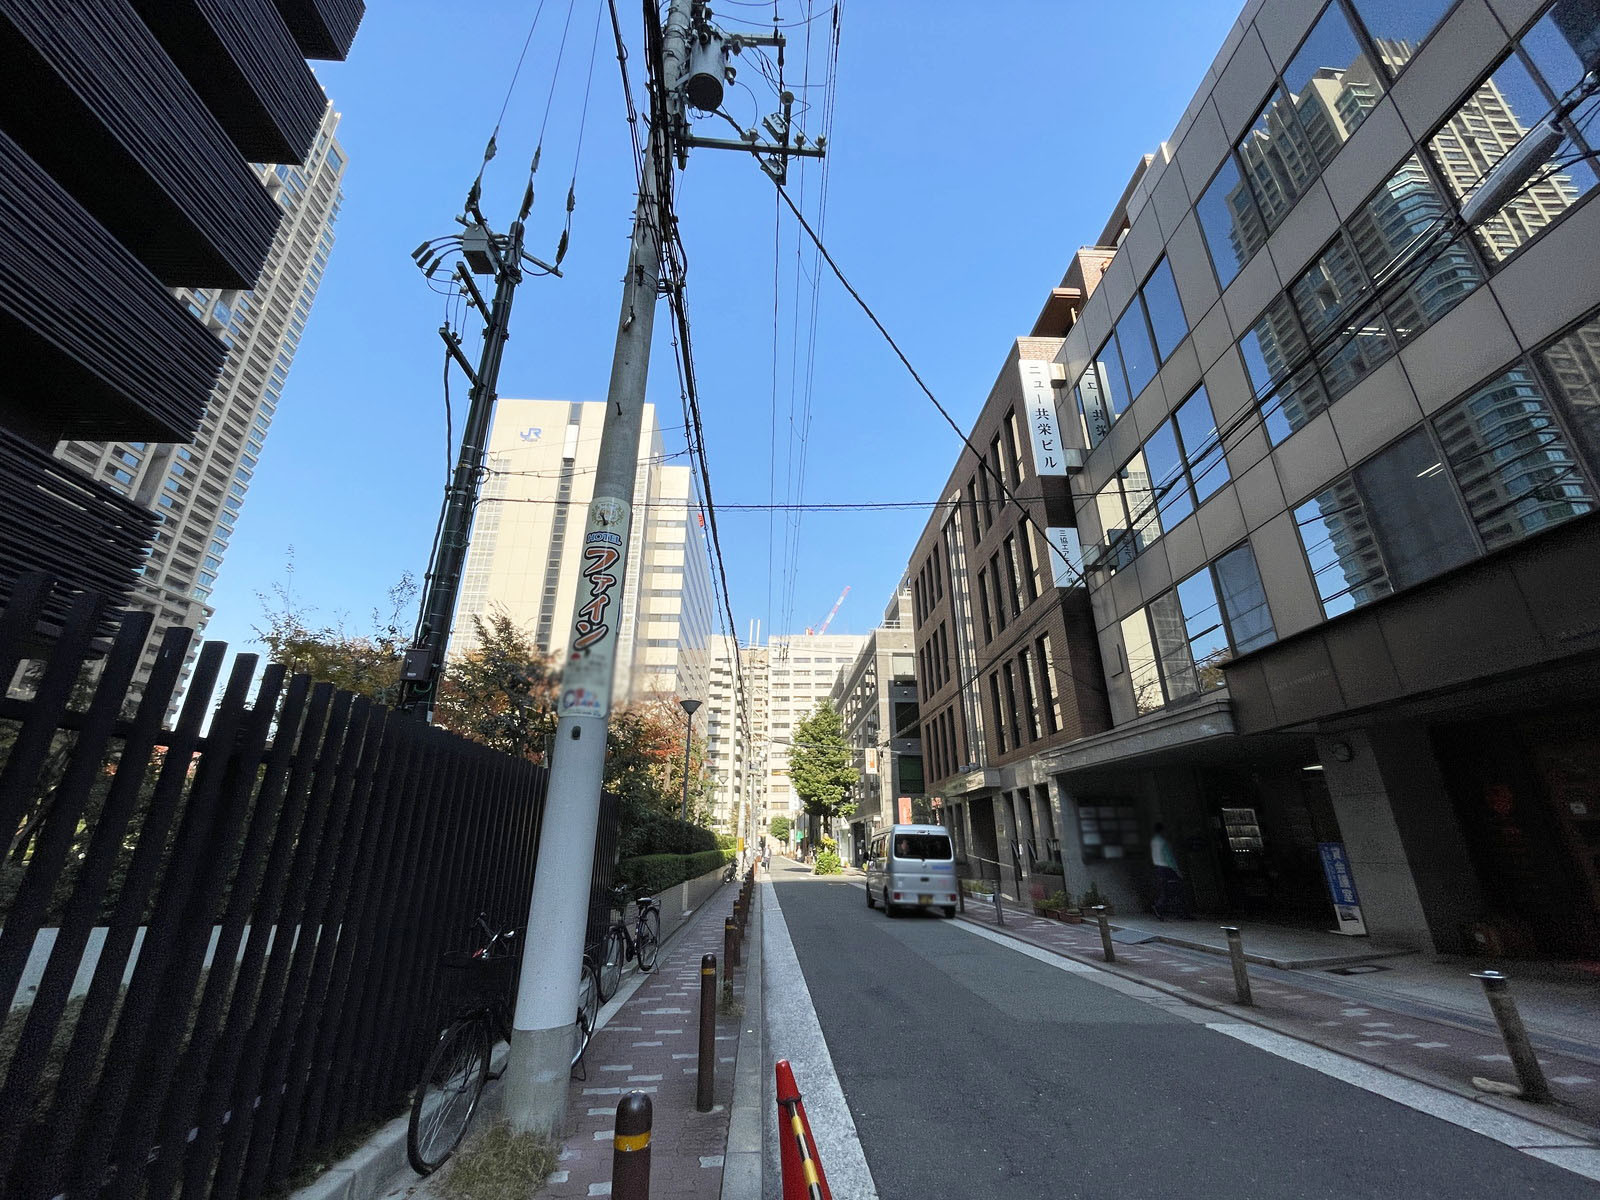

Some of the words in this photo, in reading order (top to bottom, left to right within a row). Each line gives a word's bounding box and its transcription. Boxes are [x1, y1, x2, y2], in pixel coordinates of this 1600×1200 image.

[519, 427, 542, 441] JR
[1029, 365, 1057, 469] ニュー共栄ビル
[586, 531, 622, 546] HOTEL
[573, 545, 620, 651] ファイン
